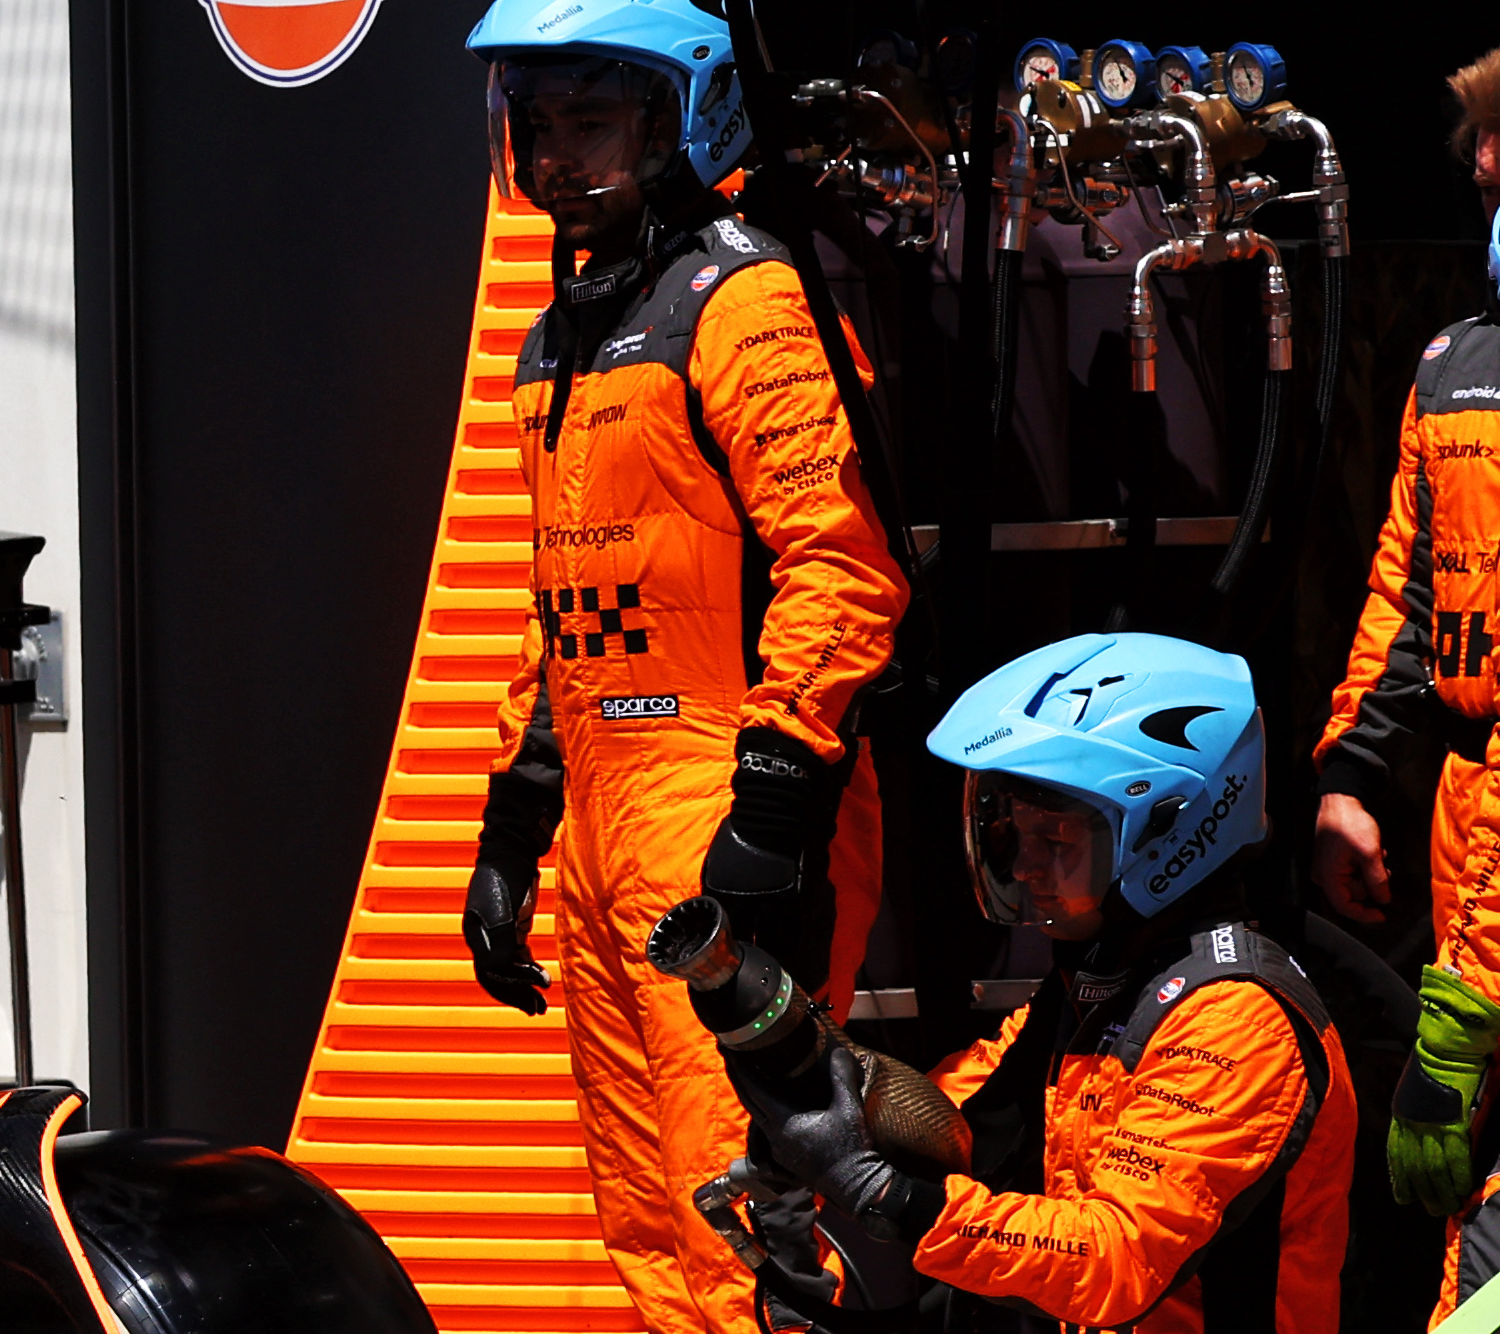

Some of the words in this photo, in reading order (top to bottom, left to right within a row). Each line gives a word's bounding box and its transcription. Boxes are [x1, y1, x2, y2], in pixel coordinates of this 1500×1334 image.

[536, 4, 584, 34] Medallia
[575, 281, 612, 301] Hilton
[744, 326, 815, 349] DARKTRACE
[754, 369, 830, 395] DataRobot
[1451, 385, 1497, 400] android
[768, 415, 839, 442] smartsheet
[773, 453, 841, 486] webex
[797, 471, 835, 491] cisco
[815, 620, 848, 676] MILLE
[602, 697, 677, 718] sparco
[963, 726, 1013, 757] Medallia
[1129, 783, 1149, 794] BELL
[1148, 773, 1249, 896] easypost.
[1142, 1083, 1216, 1118] DataRobot
[1106, 1144, 1167, 1176] webex
[1032, 1234, 1090, 1257] MILLE
